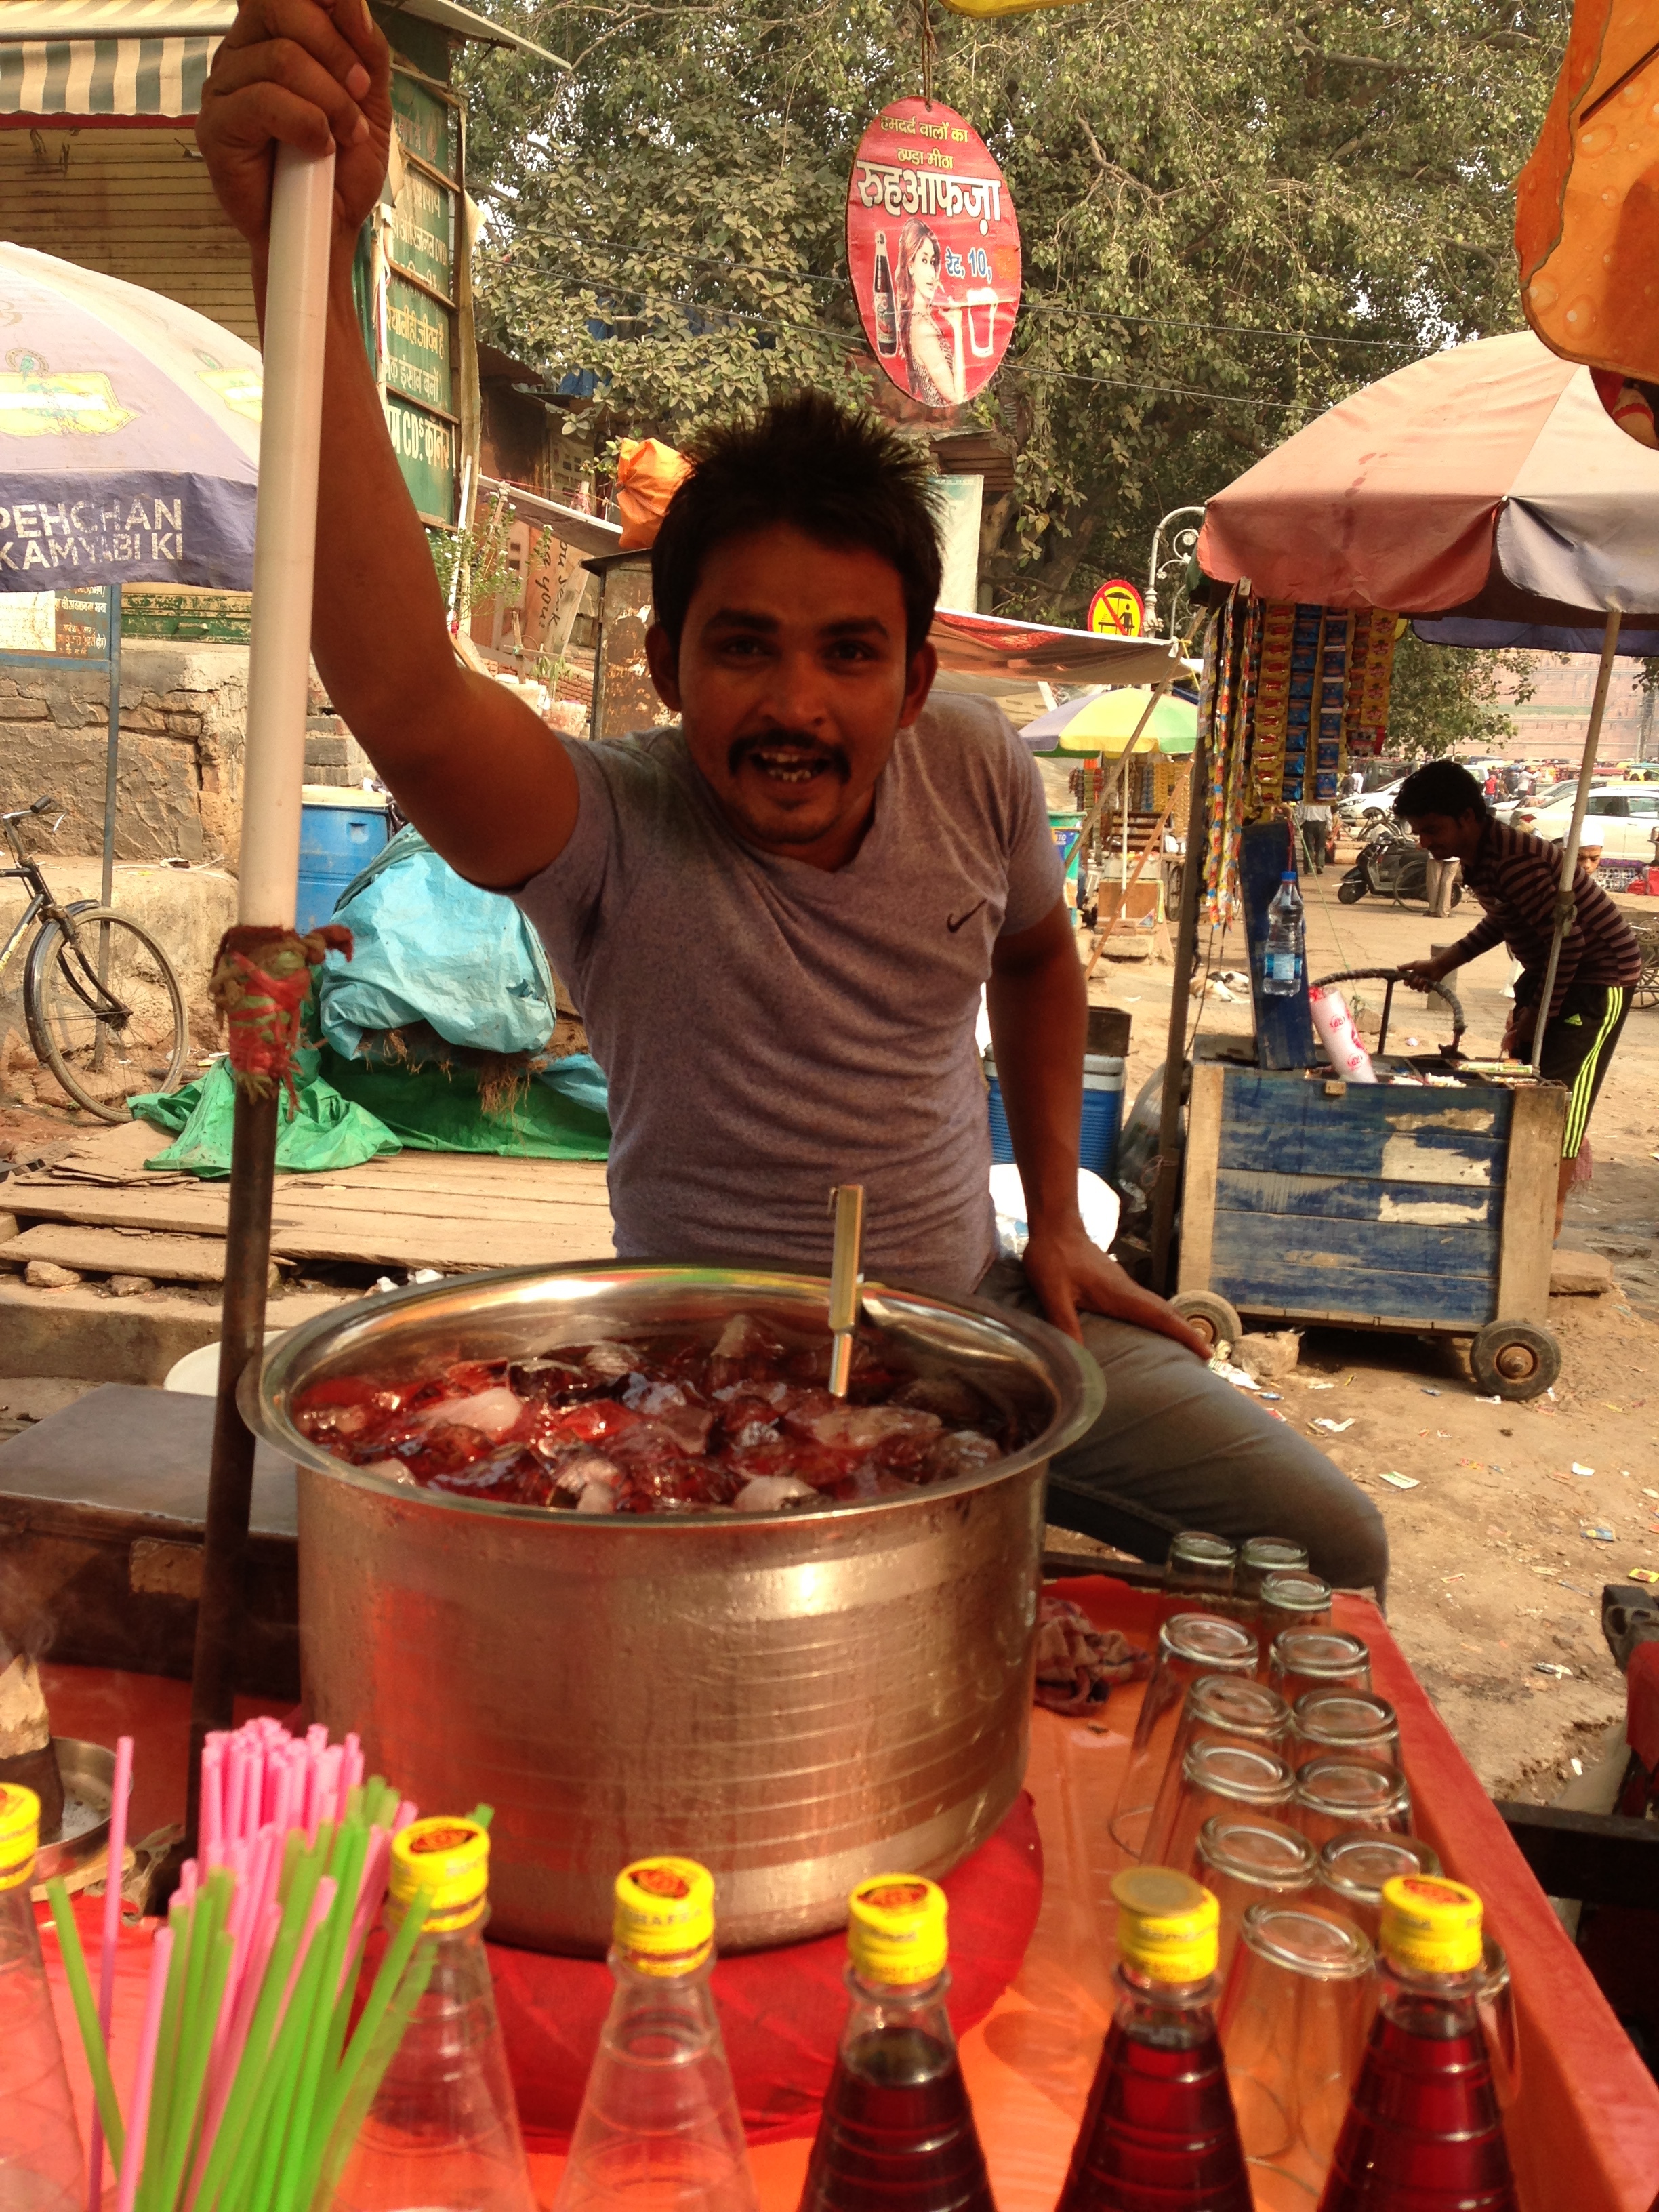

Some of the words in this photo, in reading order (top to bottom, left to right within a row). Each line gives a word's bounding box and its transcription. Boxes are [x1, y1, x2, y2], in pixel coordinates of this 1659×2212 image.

[880, 115, 916, 135] हमदर्द
[919, 121, 949, 140] वालों
[951, 127, 968, 143] का
[926, 147, 954, 169] मीठा
[151, 532, 183, 560] KI
